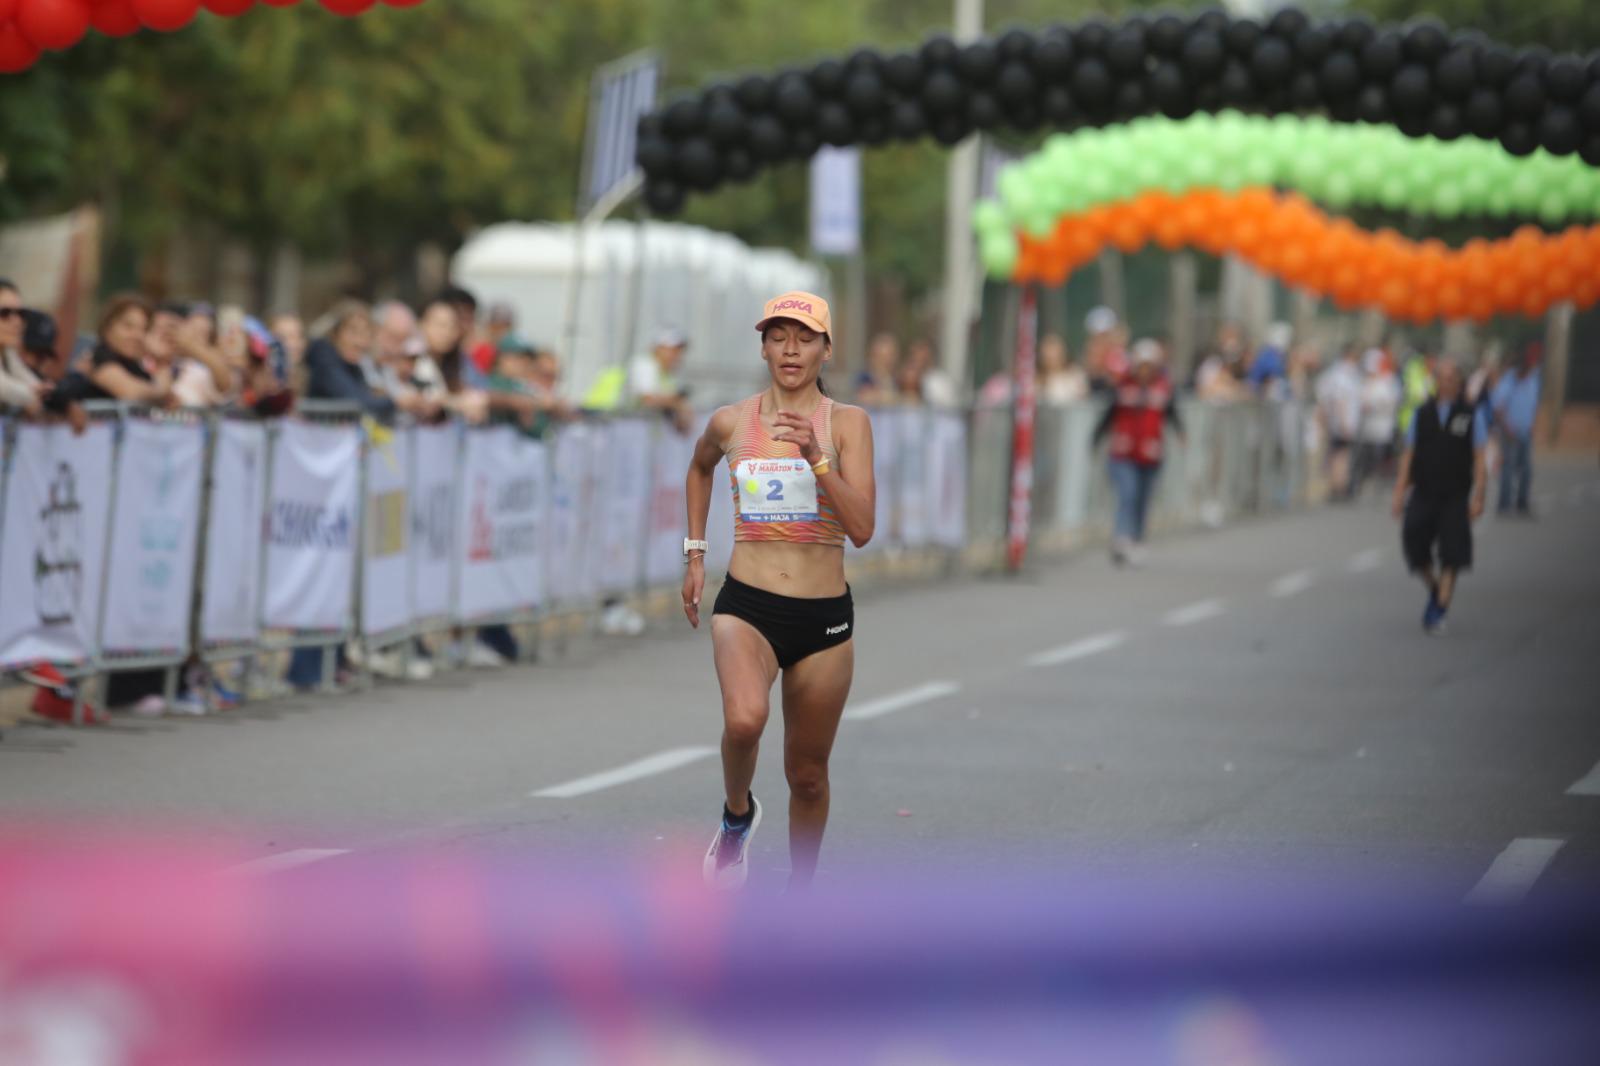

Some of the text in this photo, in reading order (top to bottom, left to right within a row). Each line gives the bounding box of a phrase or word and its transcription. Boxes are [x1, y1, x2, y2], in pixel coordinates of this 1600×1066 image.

[772, 300, 813, 315] HOKA
[766, 479, 784, 501] 2
[826, 621, 849, 635] HOKA
